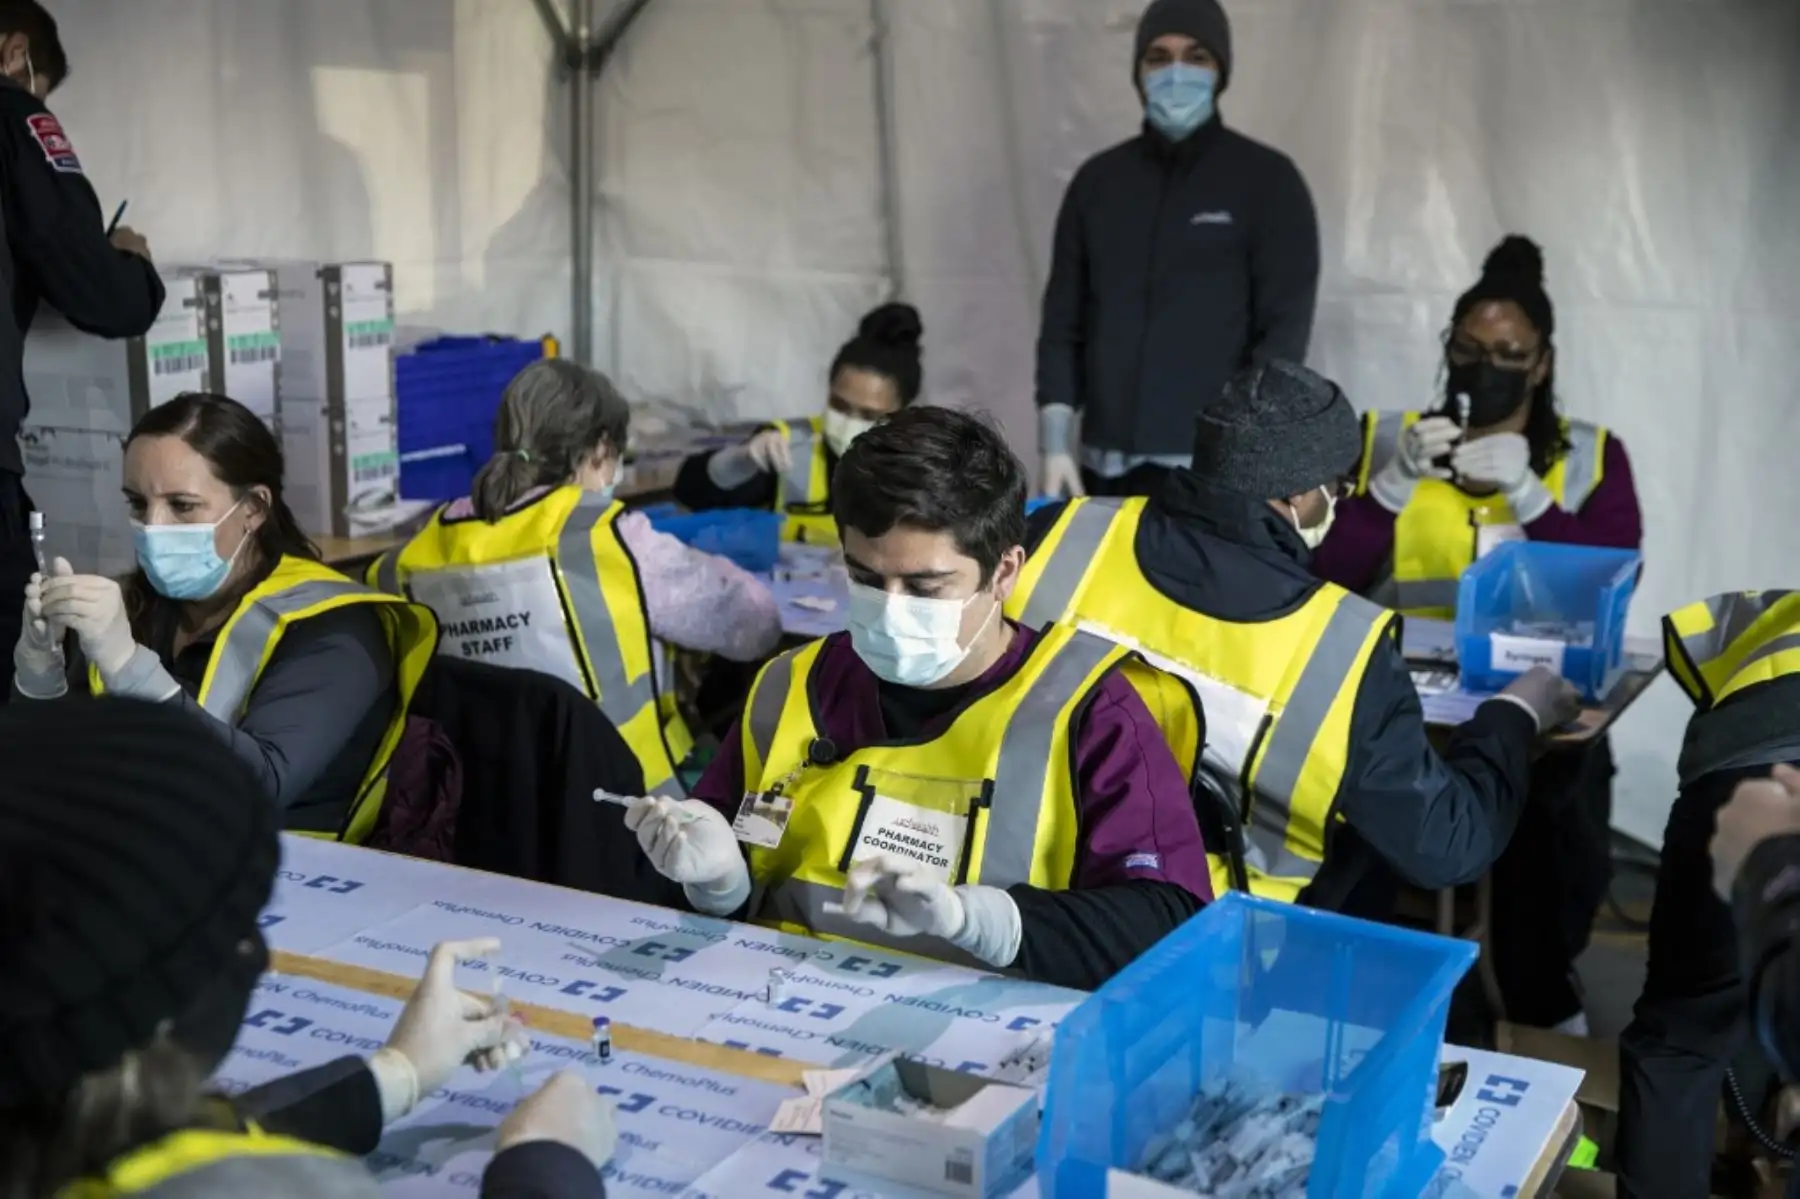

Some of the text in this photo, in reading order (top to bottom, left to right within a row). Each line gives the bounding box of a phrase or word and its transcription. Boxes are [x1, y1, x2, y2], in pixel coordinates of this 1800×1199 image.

[461, 635, 514, 657] STAFF
[863, 835, 949, 868] COORDINATOR
[877, 826, 945, 853] PHARMACY
[529, 921, 631, 948] COVIDIEN
[884, 993, 1001, 1023] COVIDIEN
[621, 1060, 740, 1097] ChemoPlus
[1448, 1106, 1501, 1167] COVIDIEN
